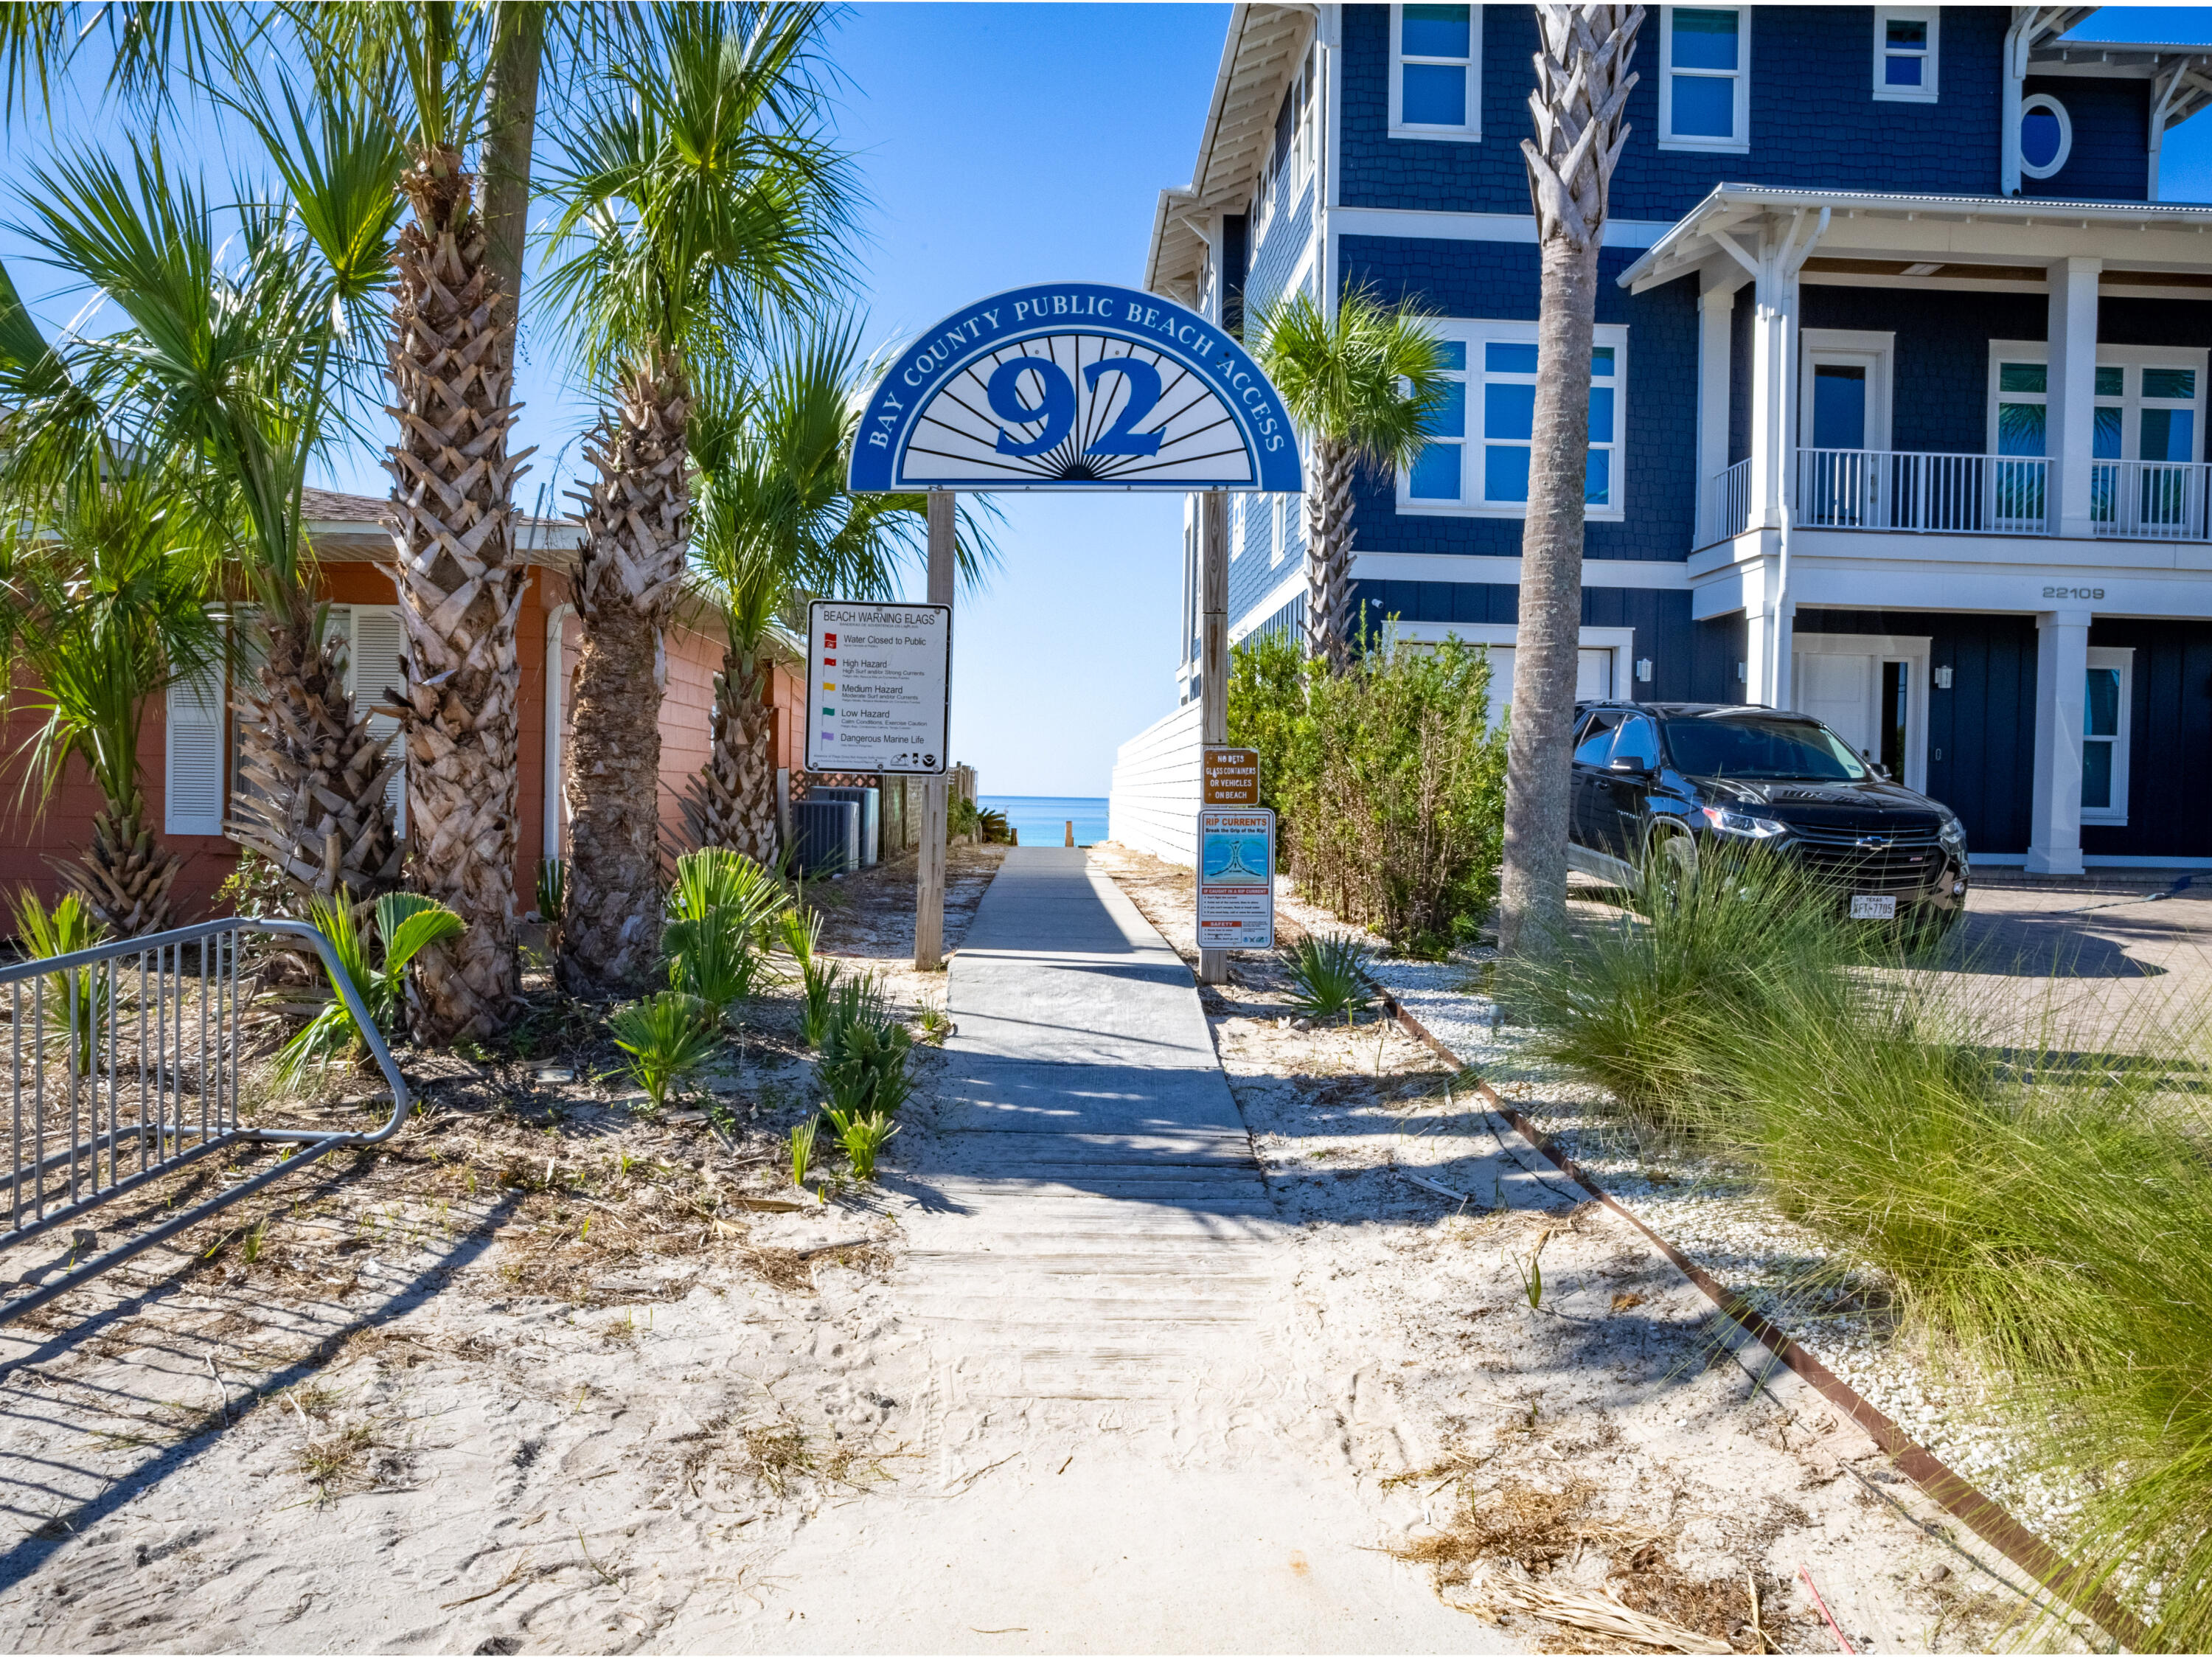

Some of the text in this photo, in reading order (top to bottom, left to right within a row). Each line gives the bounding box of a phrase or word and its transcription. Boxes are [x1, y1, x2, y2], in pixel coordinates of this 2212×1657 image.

[869, 295, 1285, 452] BAY COUNTY PUBLIC BEACH ACCESS
[987, 356, 1167, 457] 92
[2042, 586, 2105, 600] 22109
[824, 611, 855, 622] BEACH
[858, 612, 902, 623] WARNING
[844, 635, 866, 644] Water
[868, 635, 892, 645] Closed
[905, 636, 926, 645] Public
[843, 659, 887, 669] High Hazard
[842, 684, 902, 694] Medium Hazard
[841, 709, 890, 718] Low Hazard
[841, 733, 925, 744] Dangerous Marine Life
[1228, 755, 1245, 763] PETS
[1206, 818, 1267, 826] RIP CURRENTS
